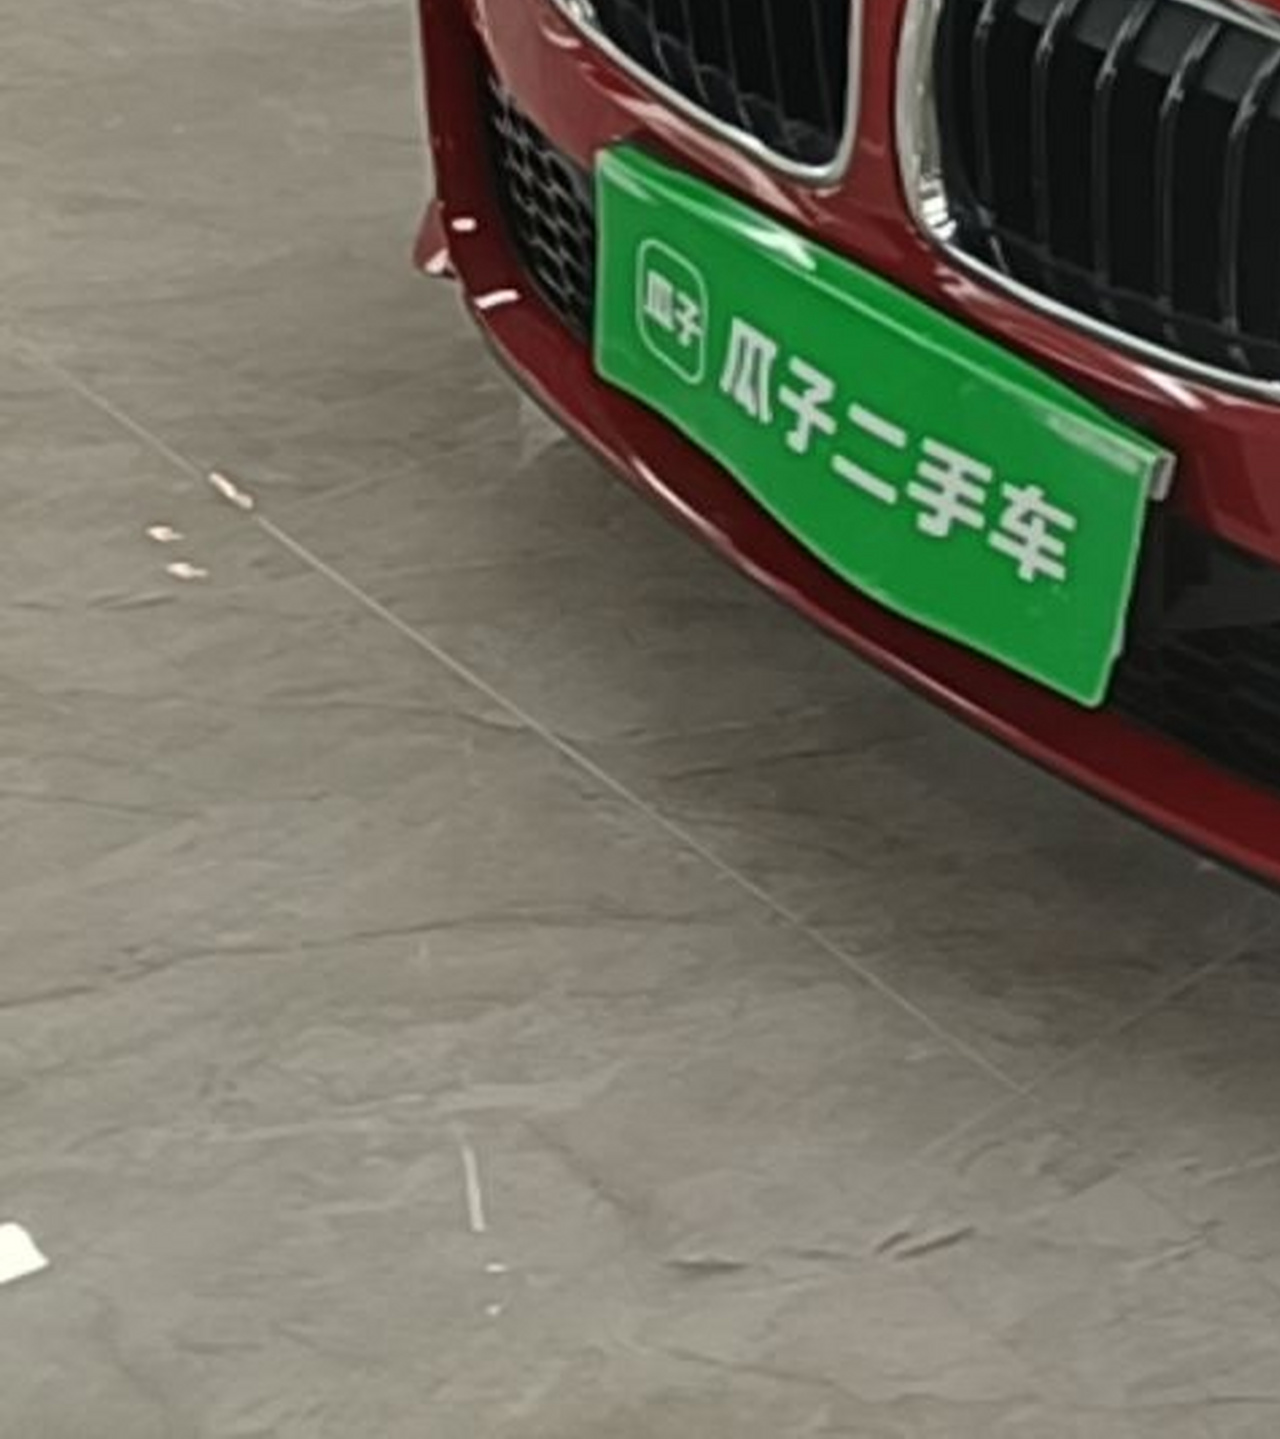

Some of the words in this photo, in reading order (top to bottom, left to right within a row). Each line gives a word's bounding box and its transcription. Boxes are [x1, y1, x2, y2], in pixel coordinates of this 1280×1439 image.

[720, 318, 1076, 582] 瓜子二手车
